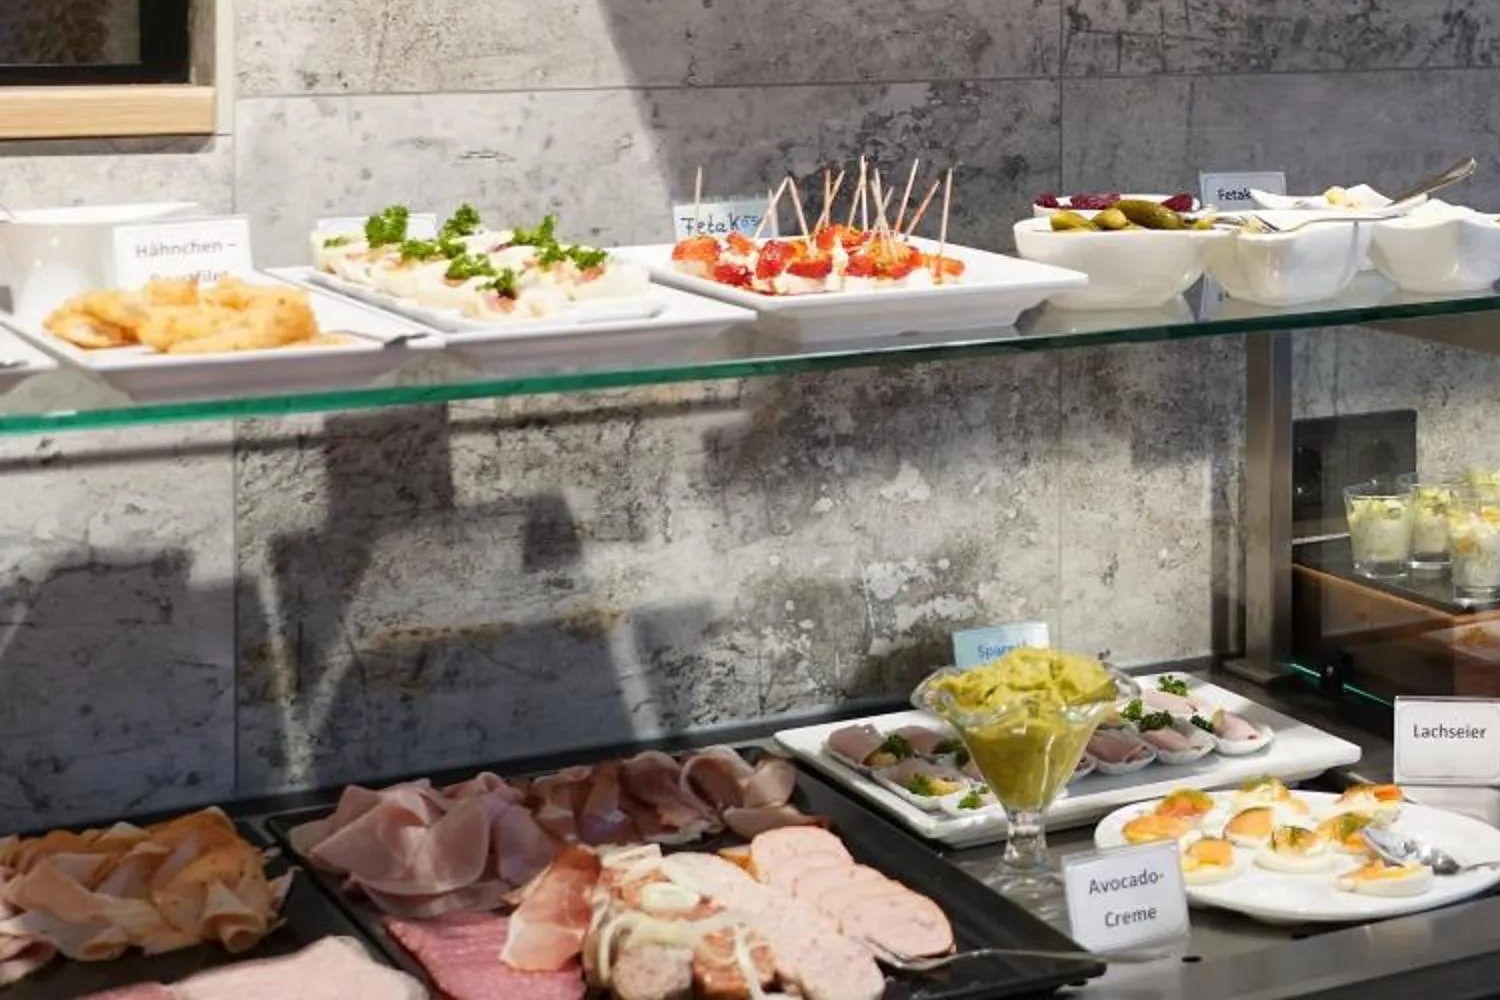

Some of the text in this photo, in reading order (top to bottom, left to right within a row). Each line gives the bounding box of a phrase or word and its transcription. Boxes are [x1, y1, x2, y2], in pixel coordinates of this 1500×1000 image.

[1217, 187, 1252, 201] Fetak
[1412, 722, 1488, 740] Lachseier
[1088, 867, 1166, 896] Avocado-
[1104, 906, 1158, 928] Creme
